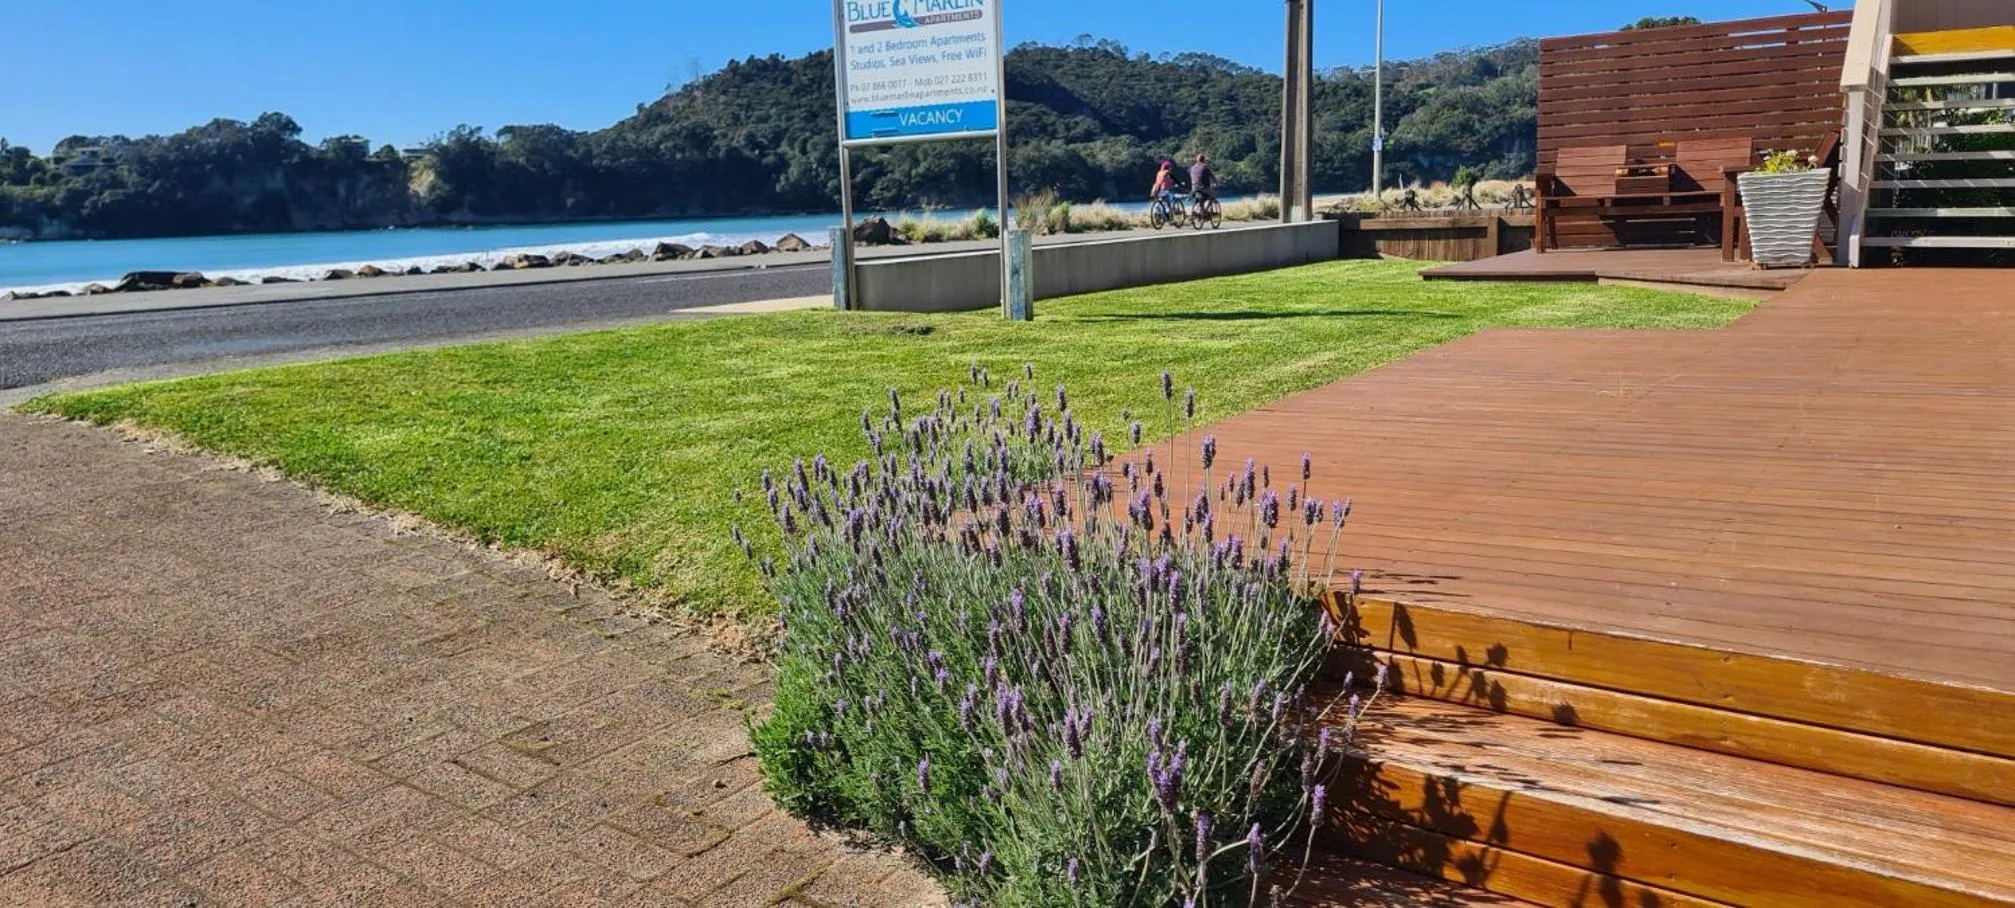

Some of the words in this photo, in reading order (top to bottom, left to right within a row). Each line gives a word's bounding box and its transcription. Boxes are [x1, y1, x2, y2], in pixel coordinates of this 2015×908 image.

[848, 1, 891, 22] BLUE
[858, 43, 875, 54] and
[877, 41, 883, 52] 2
[885, 39, 927, 52] Bedroom
[930, 32, 985, 48] Apartments
[889, 55, 906, 67] Sea
[909, 53, 938, 65] Views,
[941, 50, 962, 61] Free
[965, 47, 986, 59] WiFi
[850, 83, 860, 92] Ph
[861, 82, 870, 91] 07
[888, 79, 906, 89] 0077
[914, 76, 932, 86] Mob
[935, 74, 948, 85] 027
[951, 73, 965, 84] 222
[898, 108, 964, 126] VACANCY
